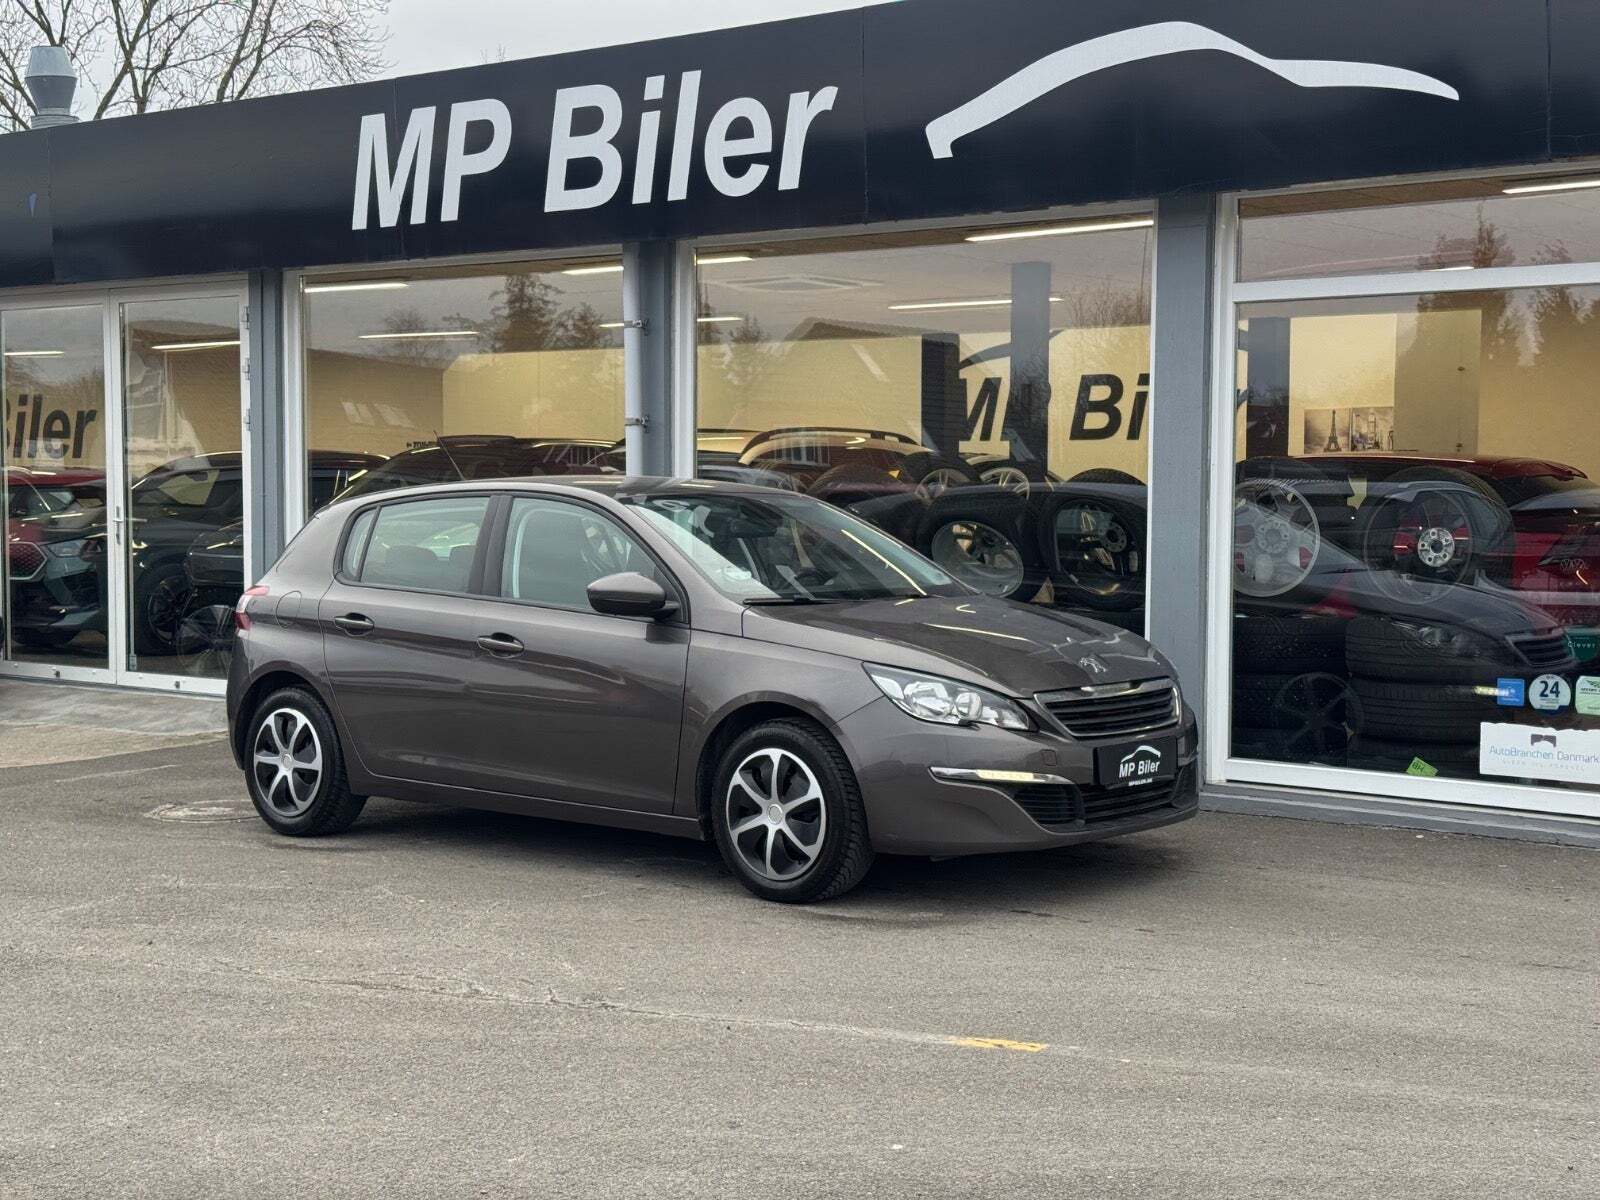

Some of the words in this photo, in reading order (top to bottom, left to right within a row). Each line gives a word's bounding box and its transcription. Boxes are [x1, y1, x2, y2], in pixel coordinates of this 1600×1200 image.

[351, 98, 512, 231] MP
[543, 69, 839, 213] Biler
[1539, 680, 1560, 698] 24
[1489, 745, 1554, 760] AutoBranchen
[1119, 762, 1135, 778] MP
[1138, 760, 1160, 775] Biler
